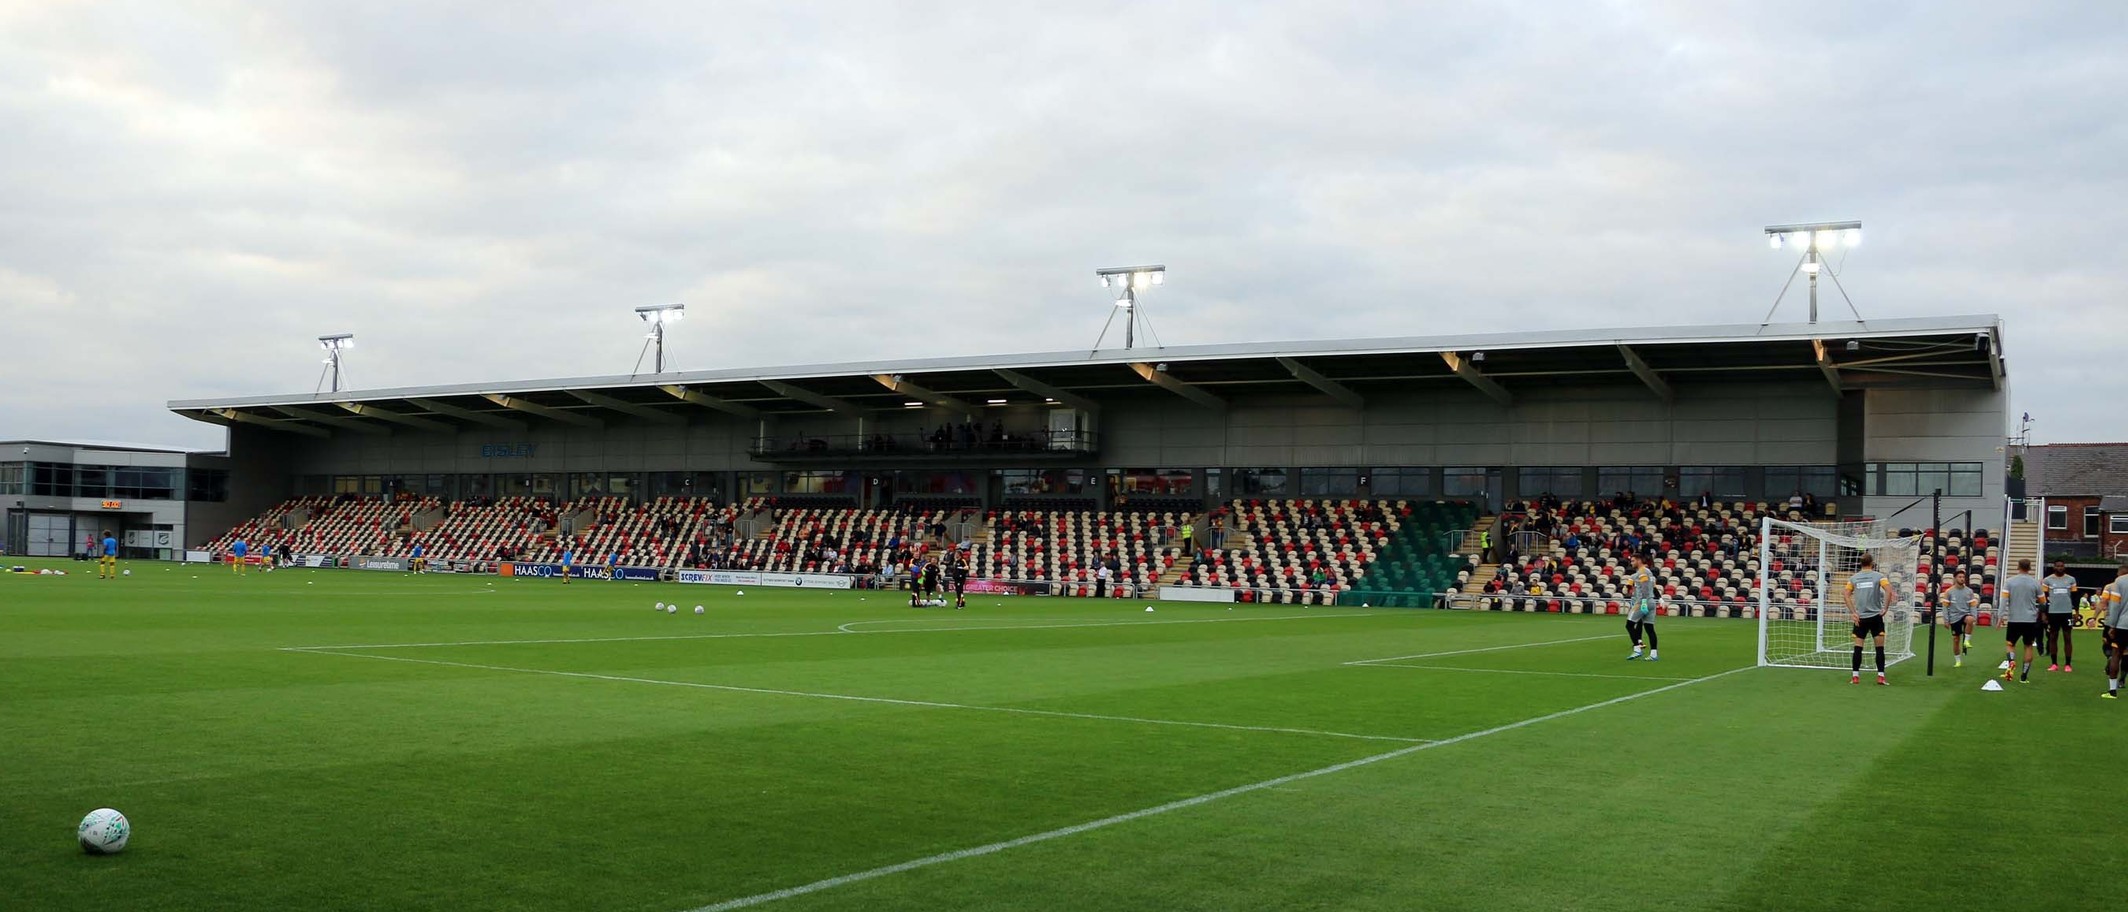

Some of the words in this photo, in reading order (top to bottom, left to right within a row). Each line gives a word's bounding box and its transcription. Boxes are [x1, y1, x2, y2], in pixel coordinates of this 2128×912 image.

[514, 565, 552, 576] HAASCO
[681, 573, 713, 583] SCREWFIX
[966, 584, 994, 592] GREATER
[994, 585, 1018, 593] CHOICE
